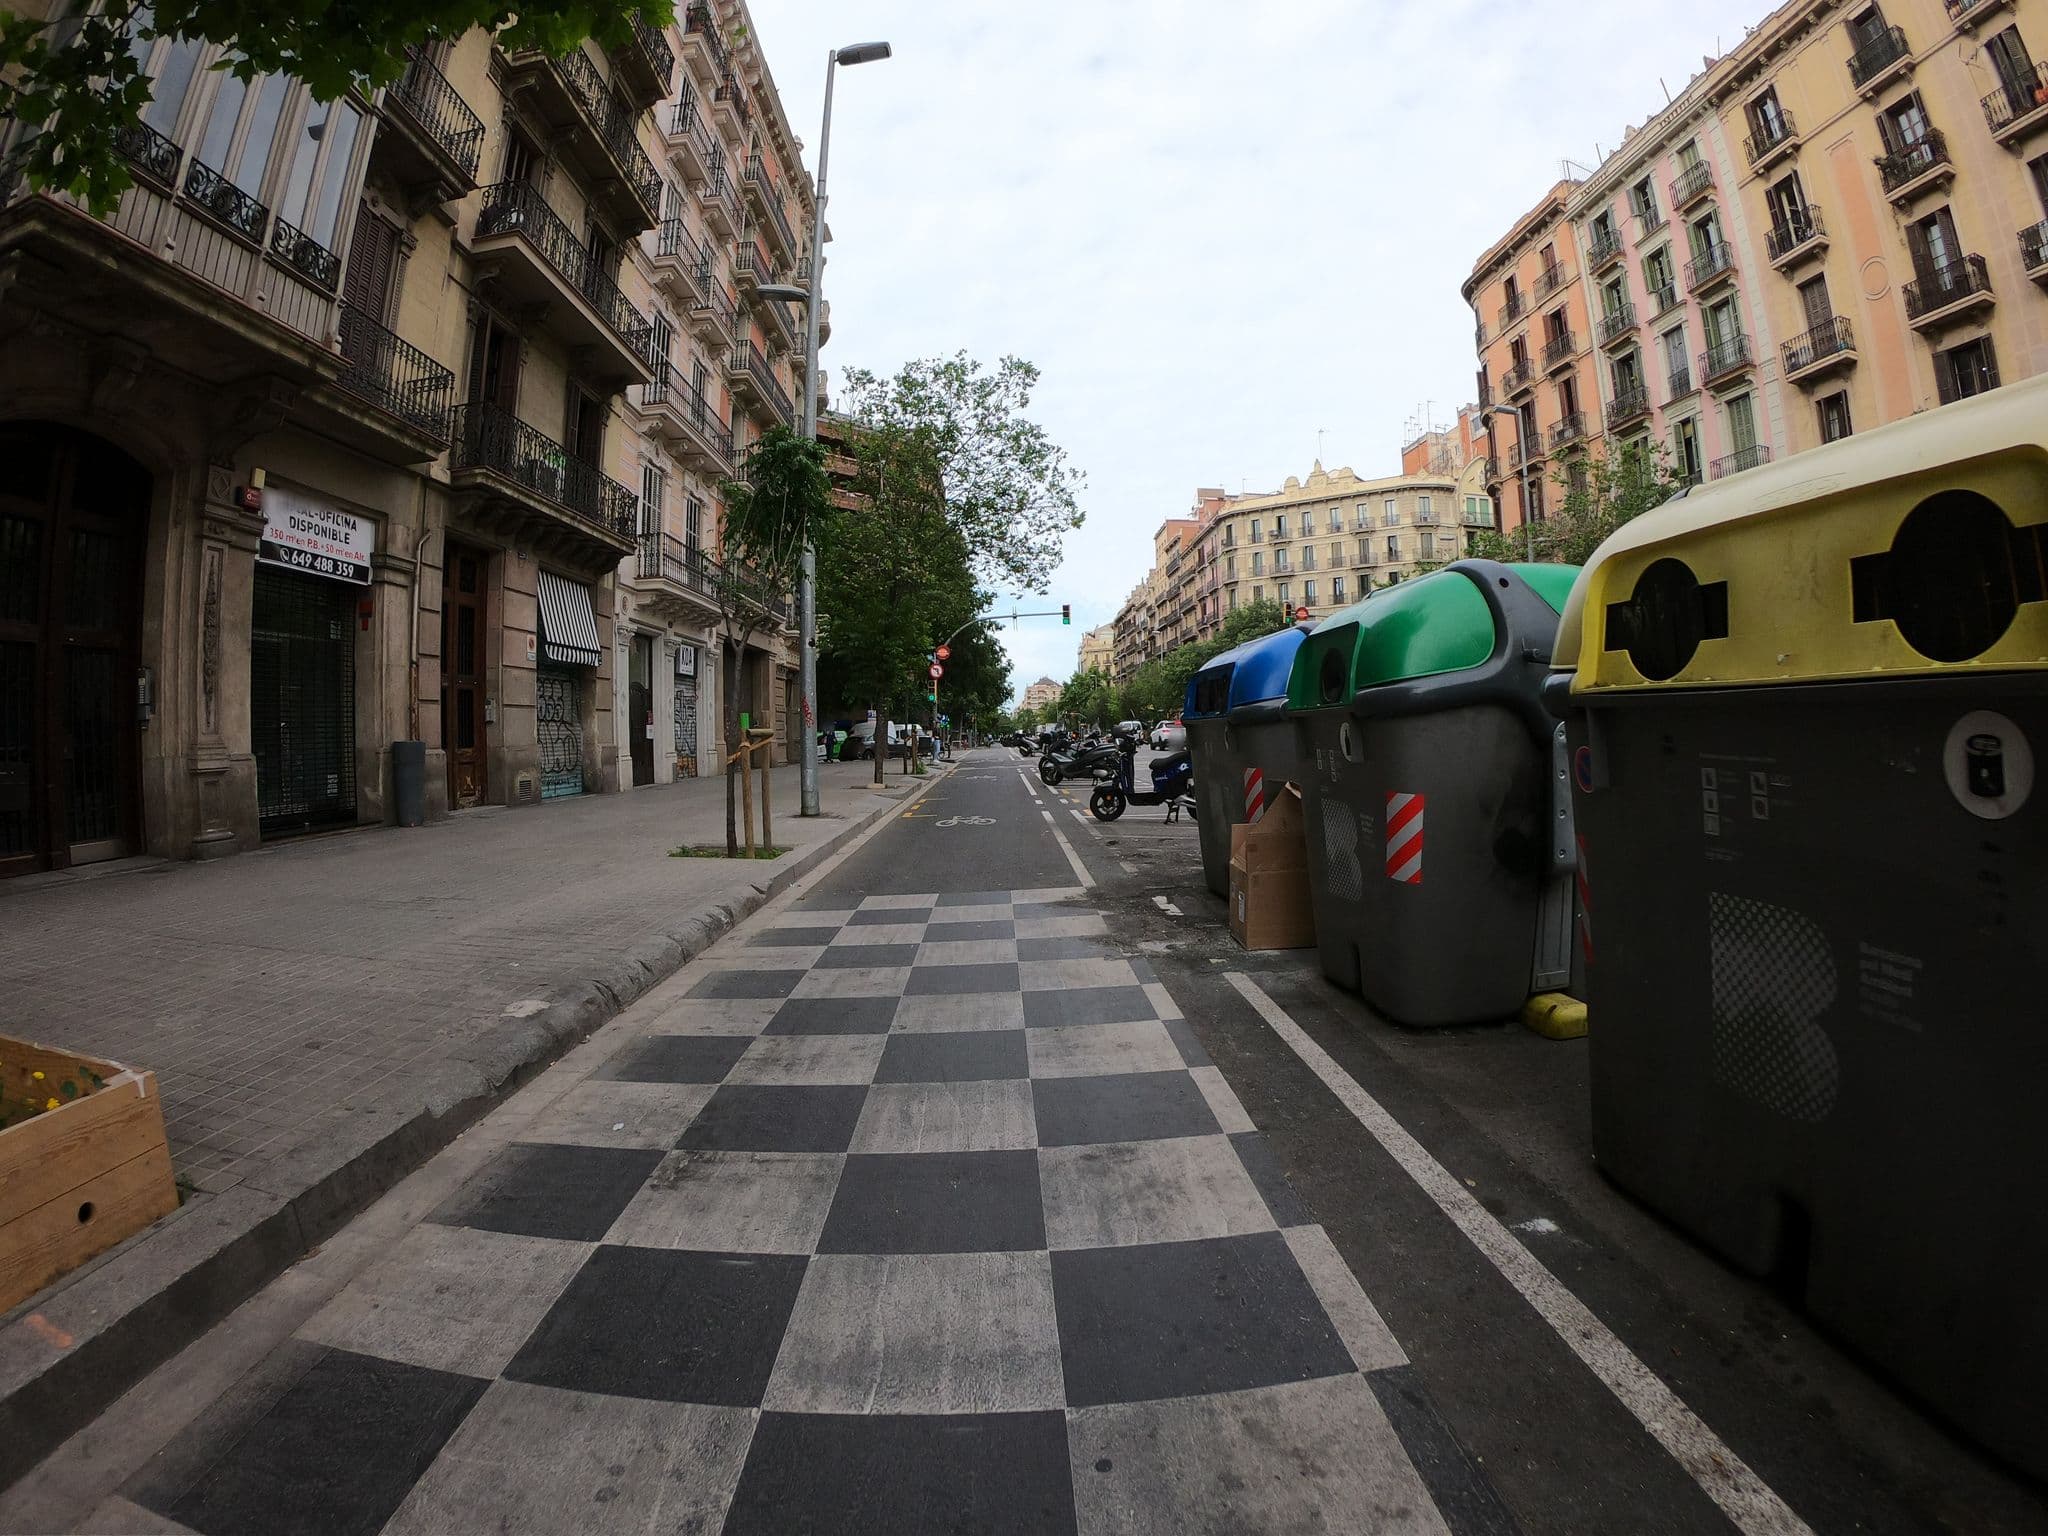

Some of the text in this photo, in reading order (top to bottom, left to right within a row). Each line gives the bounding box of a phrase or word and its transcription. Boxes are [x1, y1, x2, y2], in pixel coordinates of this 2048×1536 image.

[289, 516, 350, 545] DISPONIBLE
[292, 550, 354, 578] 649 488 359
